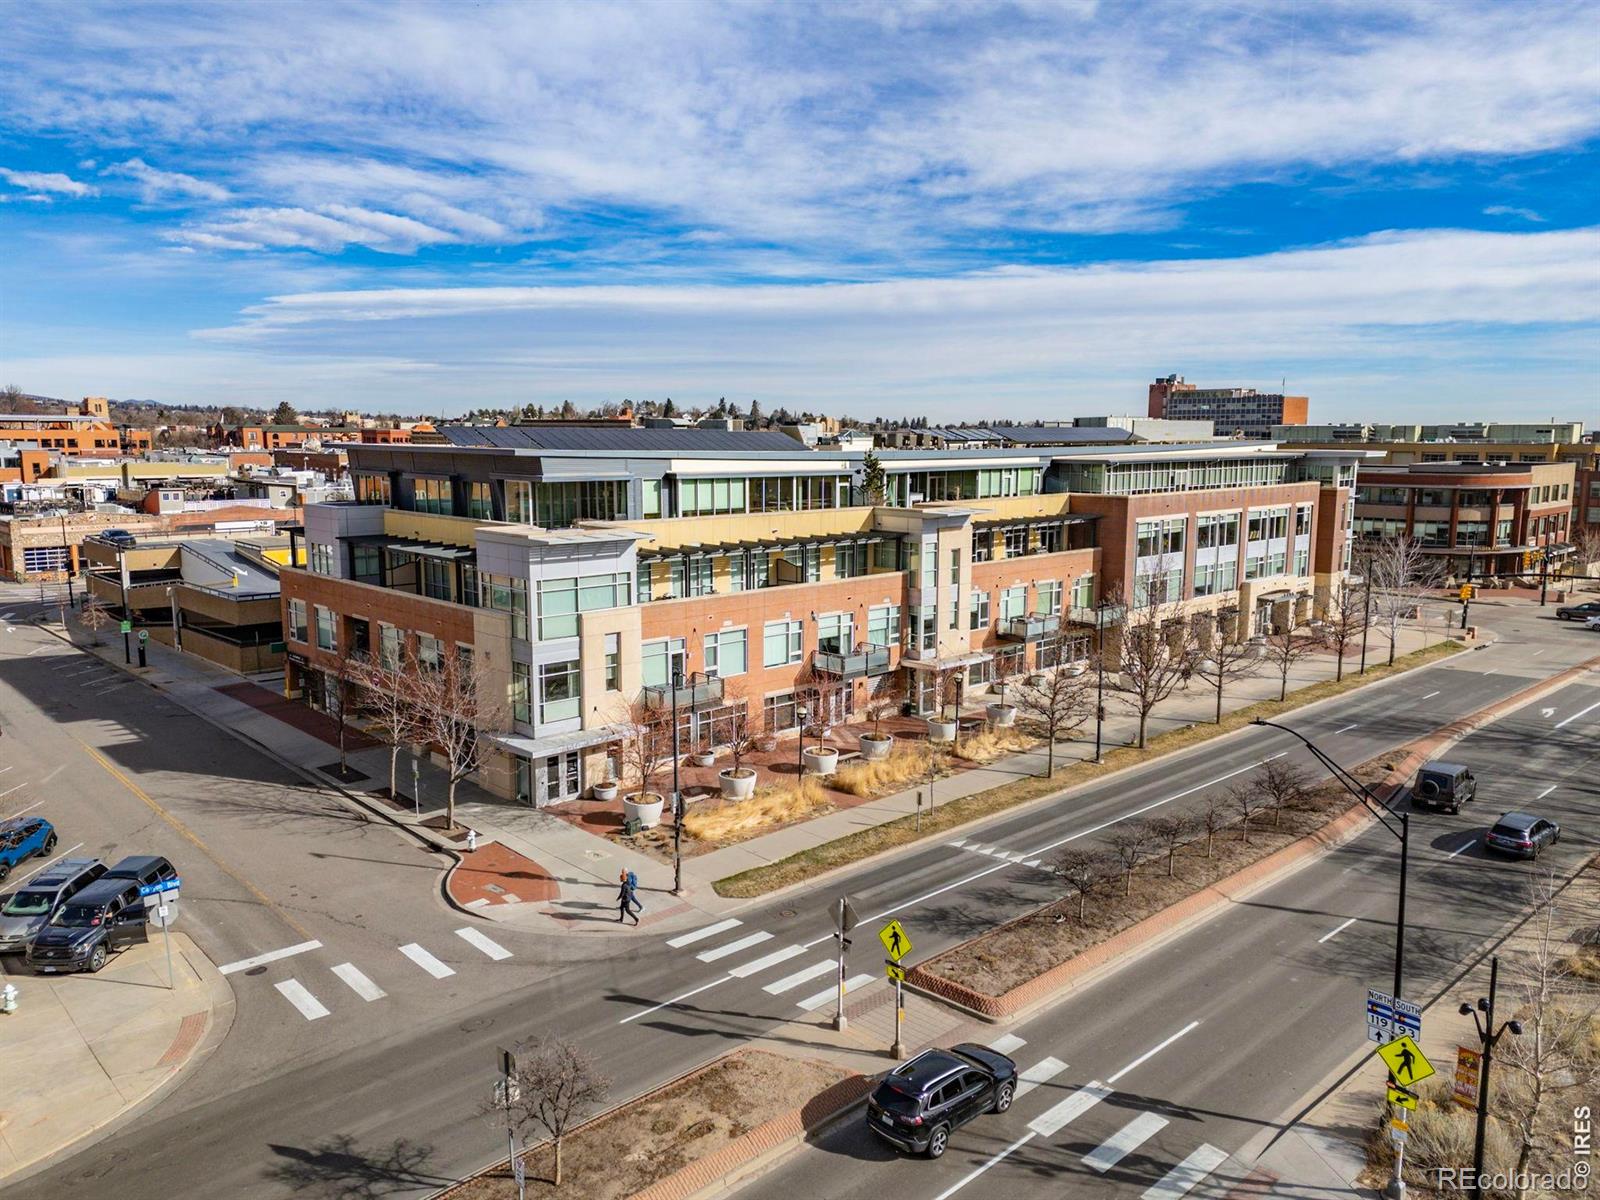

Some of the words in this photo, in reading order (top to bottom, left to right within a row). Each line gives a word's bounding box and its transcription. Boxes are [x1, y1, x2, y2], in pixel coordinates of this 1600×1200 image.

[1368, 990, 1392, 1005] NORTH
[1396, 1001, 1421, 1015] SOUTH
[1370, 1015, 1388, 1027] 119
[1398, 1026, 1415, 1038] 93
